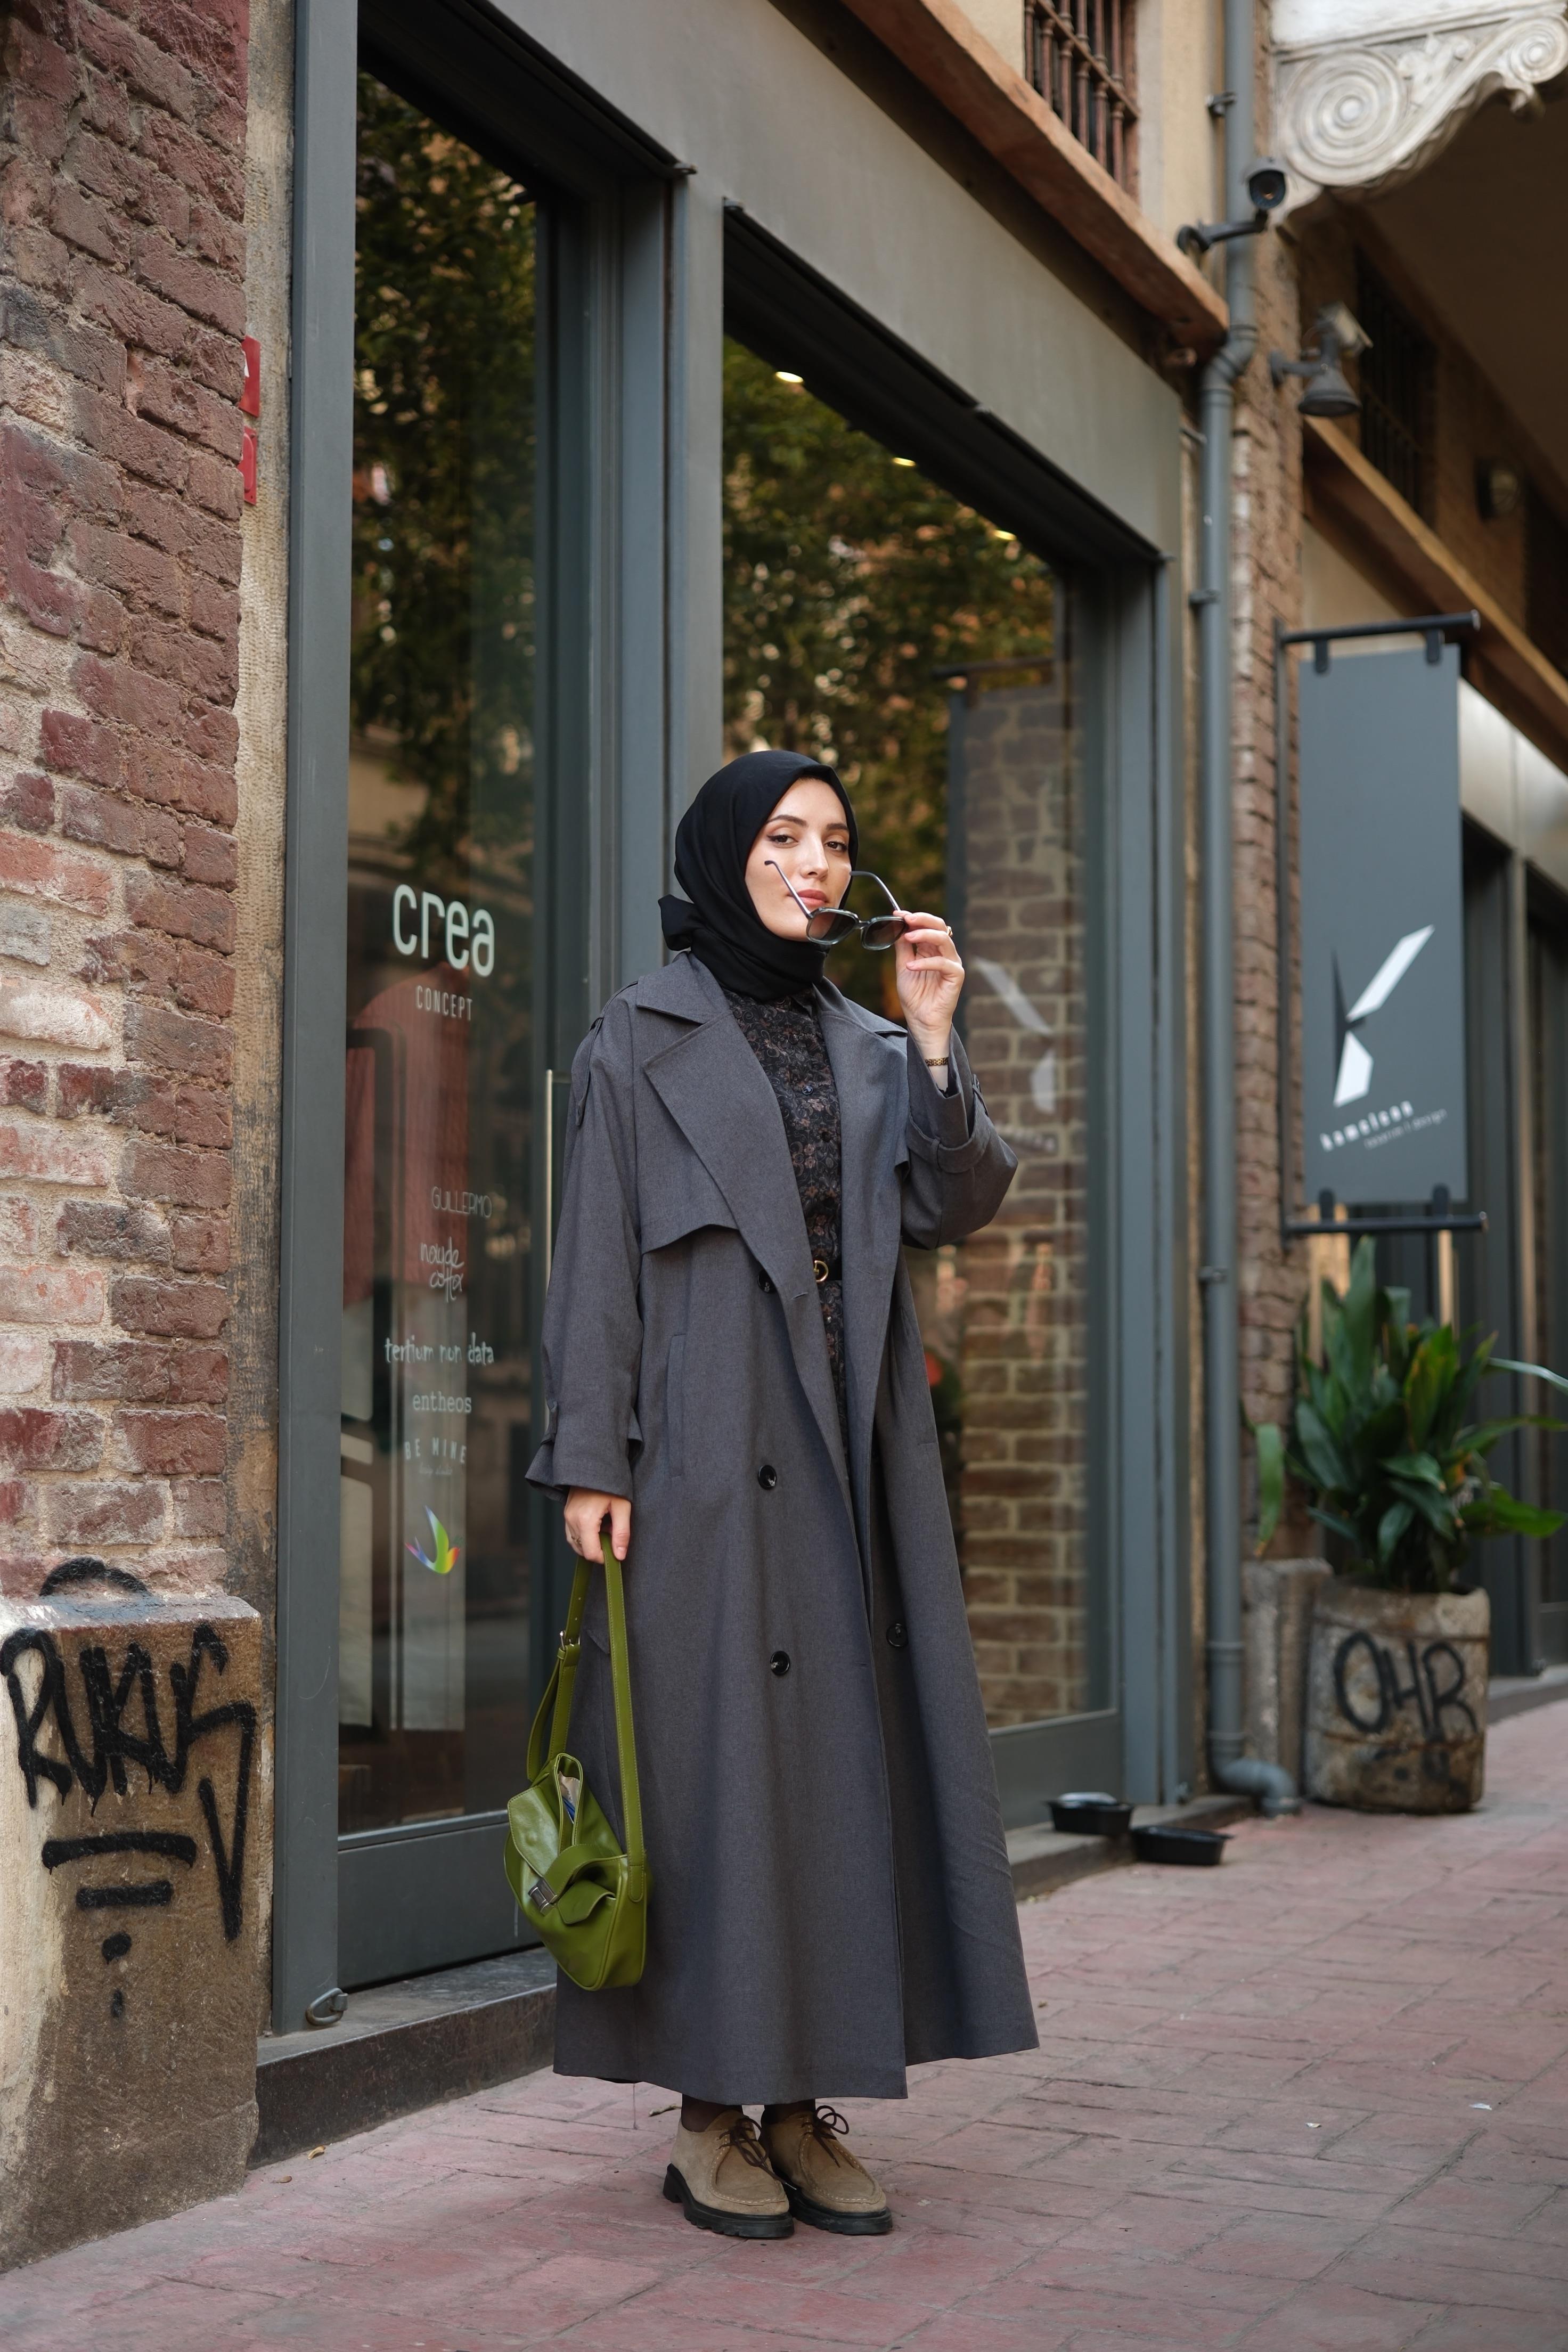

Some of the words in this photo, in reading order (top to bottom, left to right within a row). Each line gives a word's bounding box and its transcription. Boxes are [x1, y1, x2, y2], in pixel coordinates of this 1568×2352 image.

[393, 884, 495, 977] crea
[415, 985, 473, 1021] CONCEPT
[385, 1335, 434, 1363] tertium
[413, 1391, 472, 1414] entheos
[404, 1438, 421, 1460] BE
[432, 1436, 467, 1464] MINE
